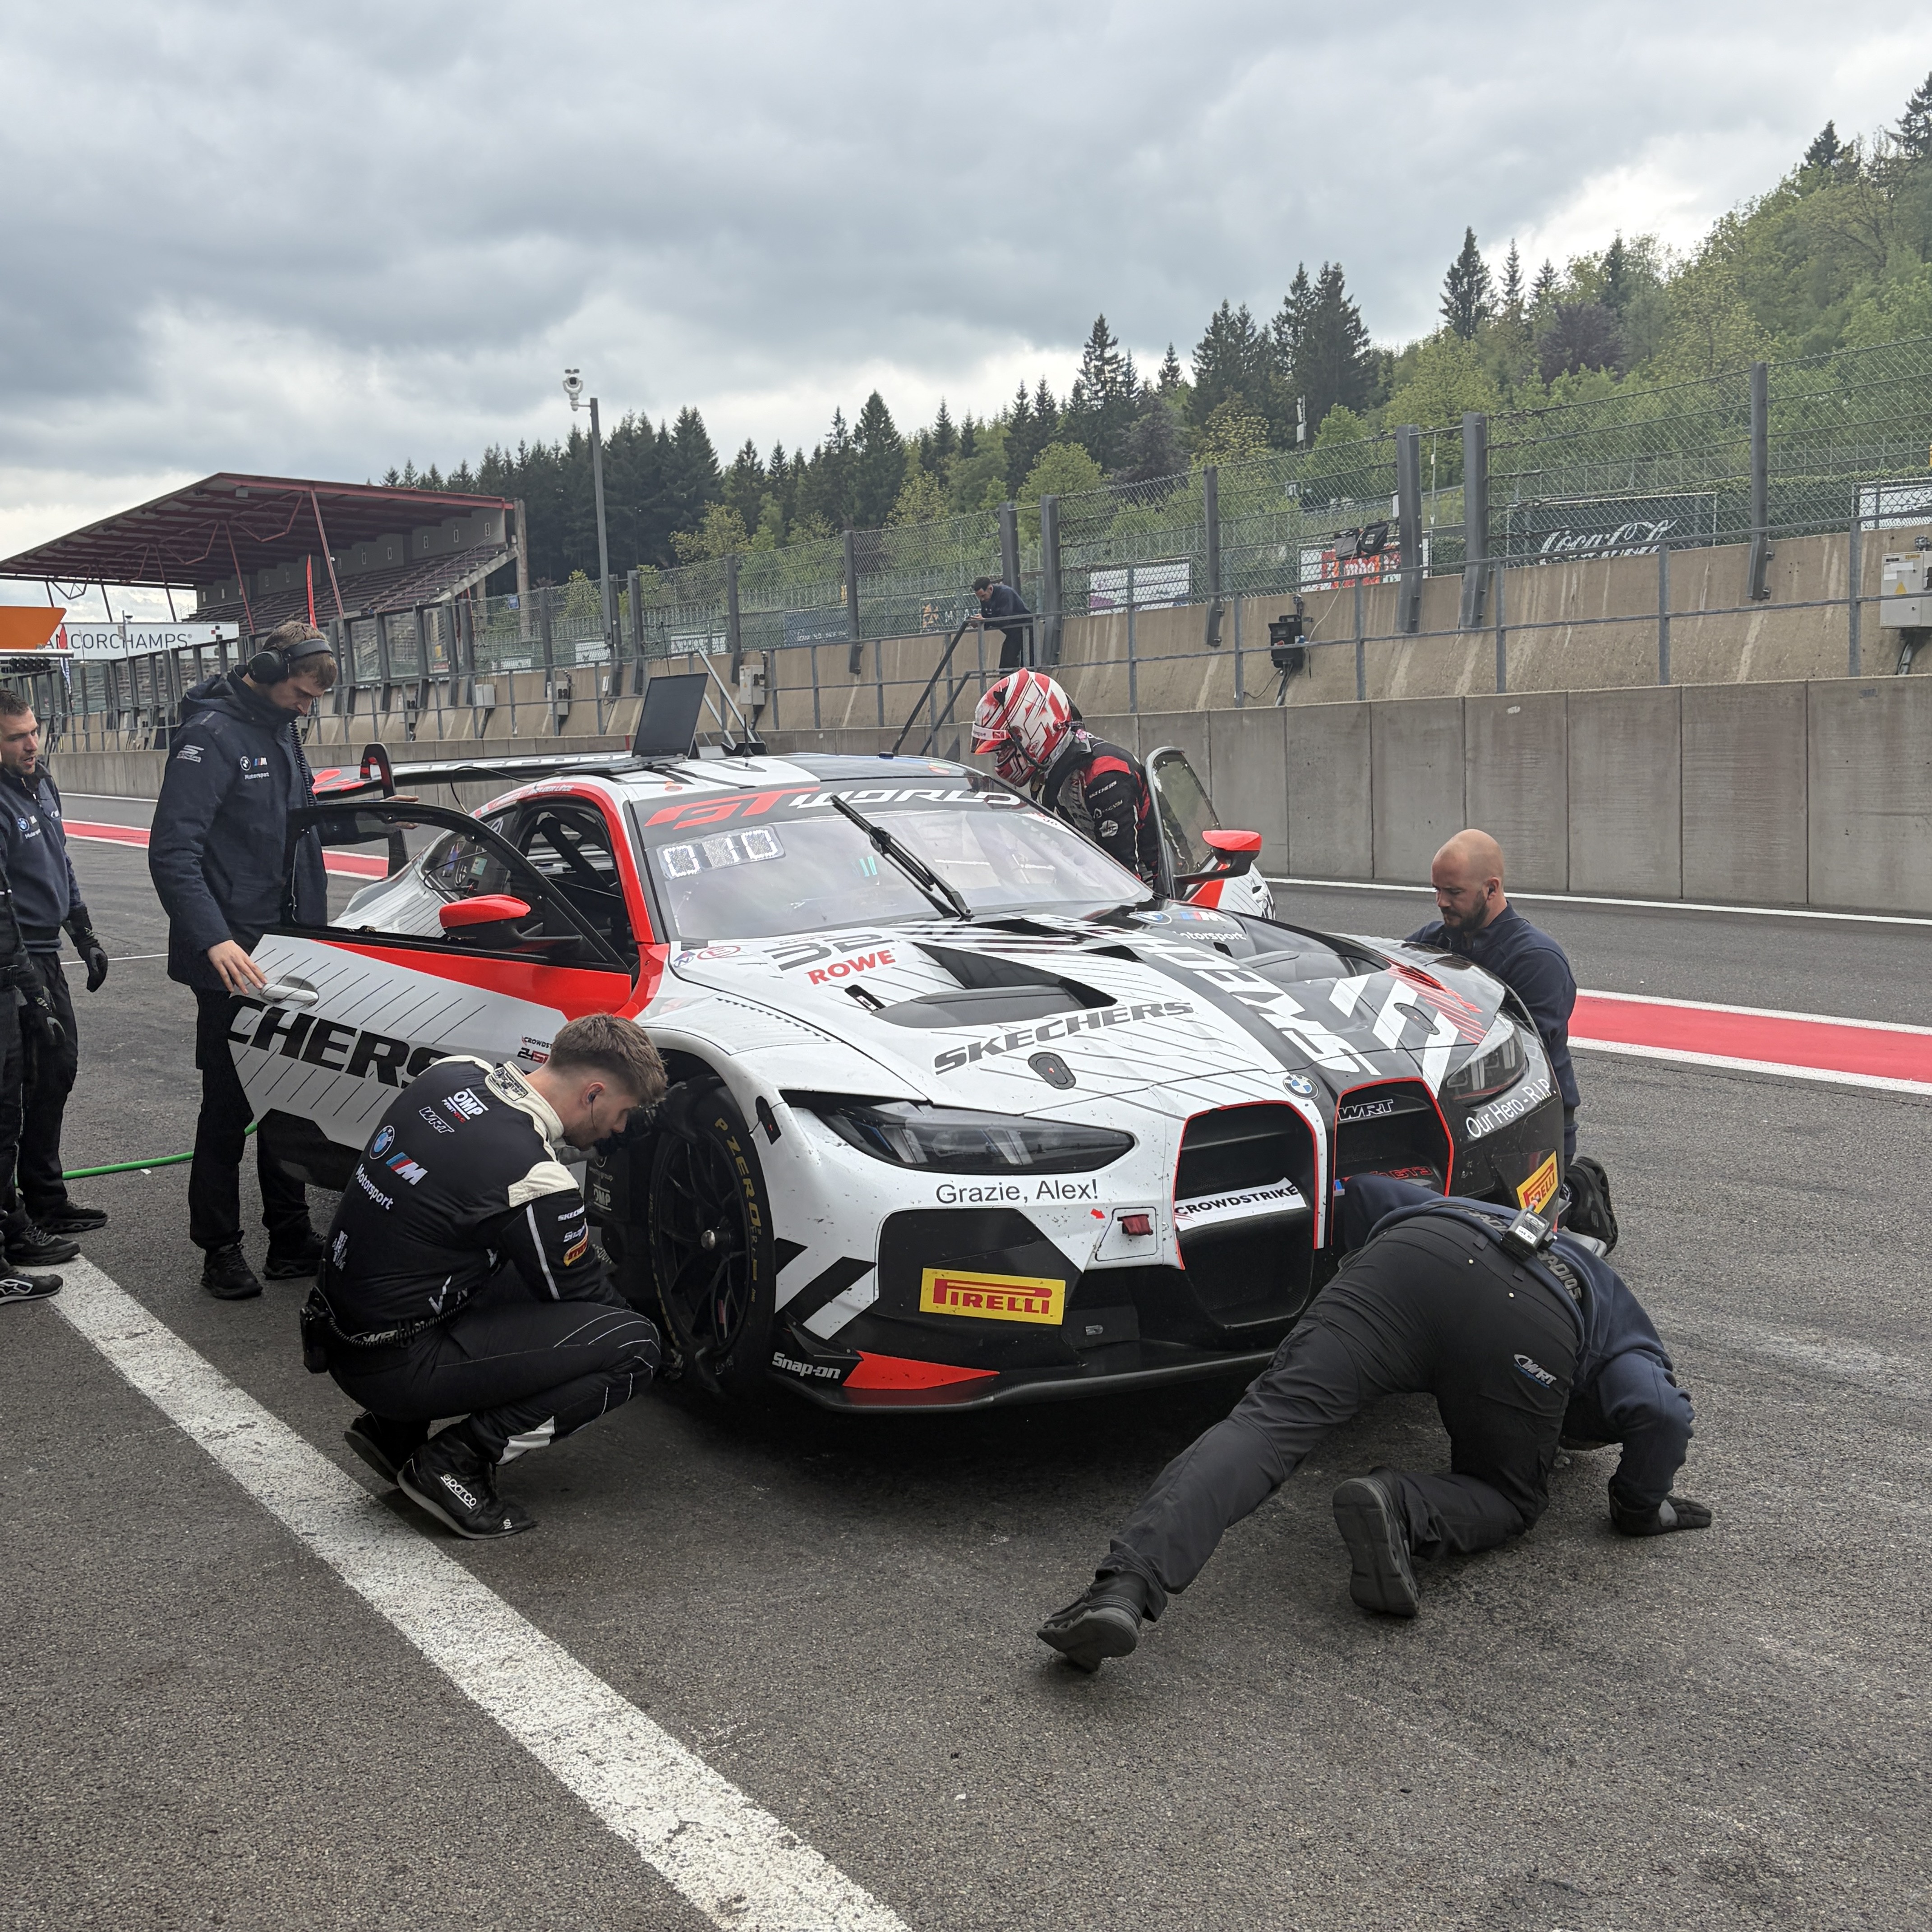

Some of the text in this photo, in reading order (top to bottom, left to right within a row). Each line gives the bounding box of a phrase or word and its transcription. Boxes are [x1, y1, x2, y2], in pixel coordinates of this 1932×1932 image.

[644, 786, 1021, 830] GT WORLD
[762, 934, 895, 971] 32
[1173, 931, 1247, 942] otorsport
[804, 949, 896, 985] ROWE
[934, 1001, 1194, 1076] SKECHERS
[419, 1106, 455, 1133] WRT
[453, 1091, 484, 1115] OMP
[1338, 1099, 1394, 1121] WRT
[1466, 1116, 1495, 1139] Our
[1488, 1099, 1525, 1125] Hero
[1522, 1078, 1557, 1104] R.I.P.
[355, 1163, 394, 1210] Motorsport
[727, 1136, 762, 1227] ZERO
[936, 1179, 1099, 1203] Grazie, Alex!
[1174, 1184, 1299, 1215] CROWDSTRIKE
[933, 1278, 1052, 1314] PIRELLI
[772, 1351, 841, 1379] Snap-on
[1522, 1358, 1557, 1385] WRT
